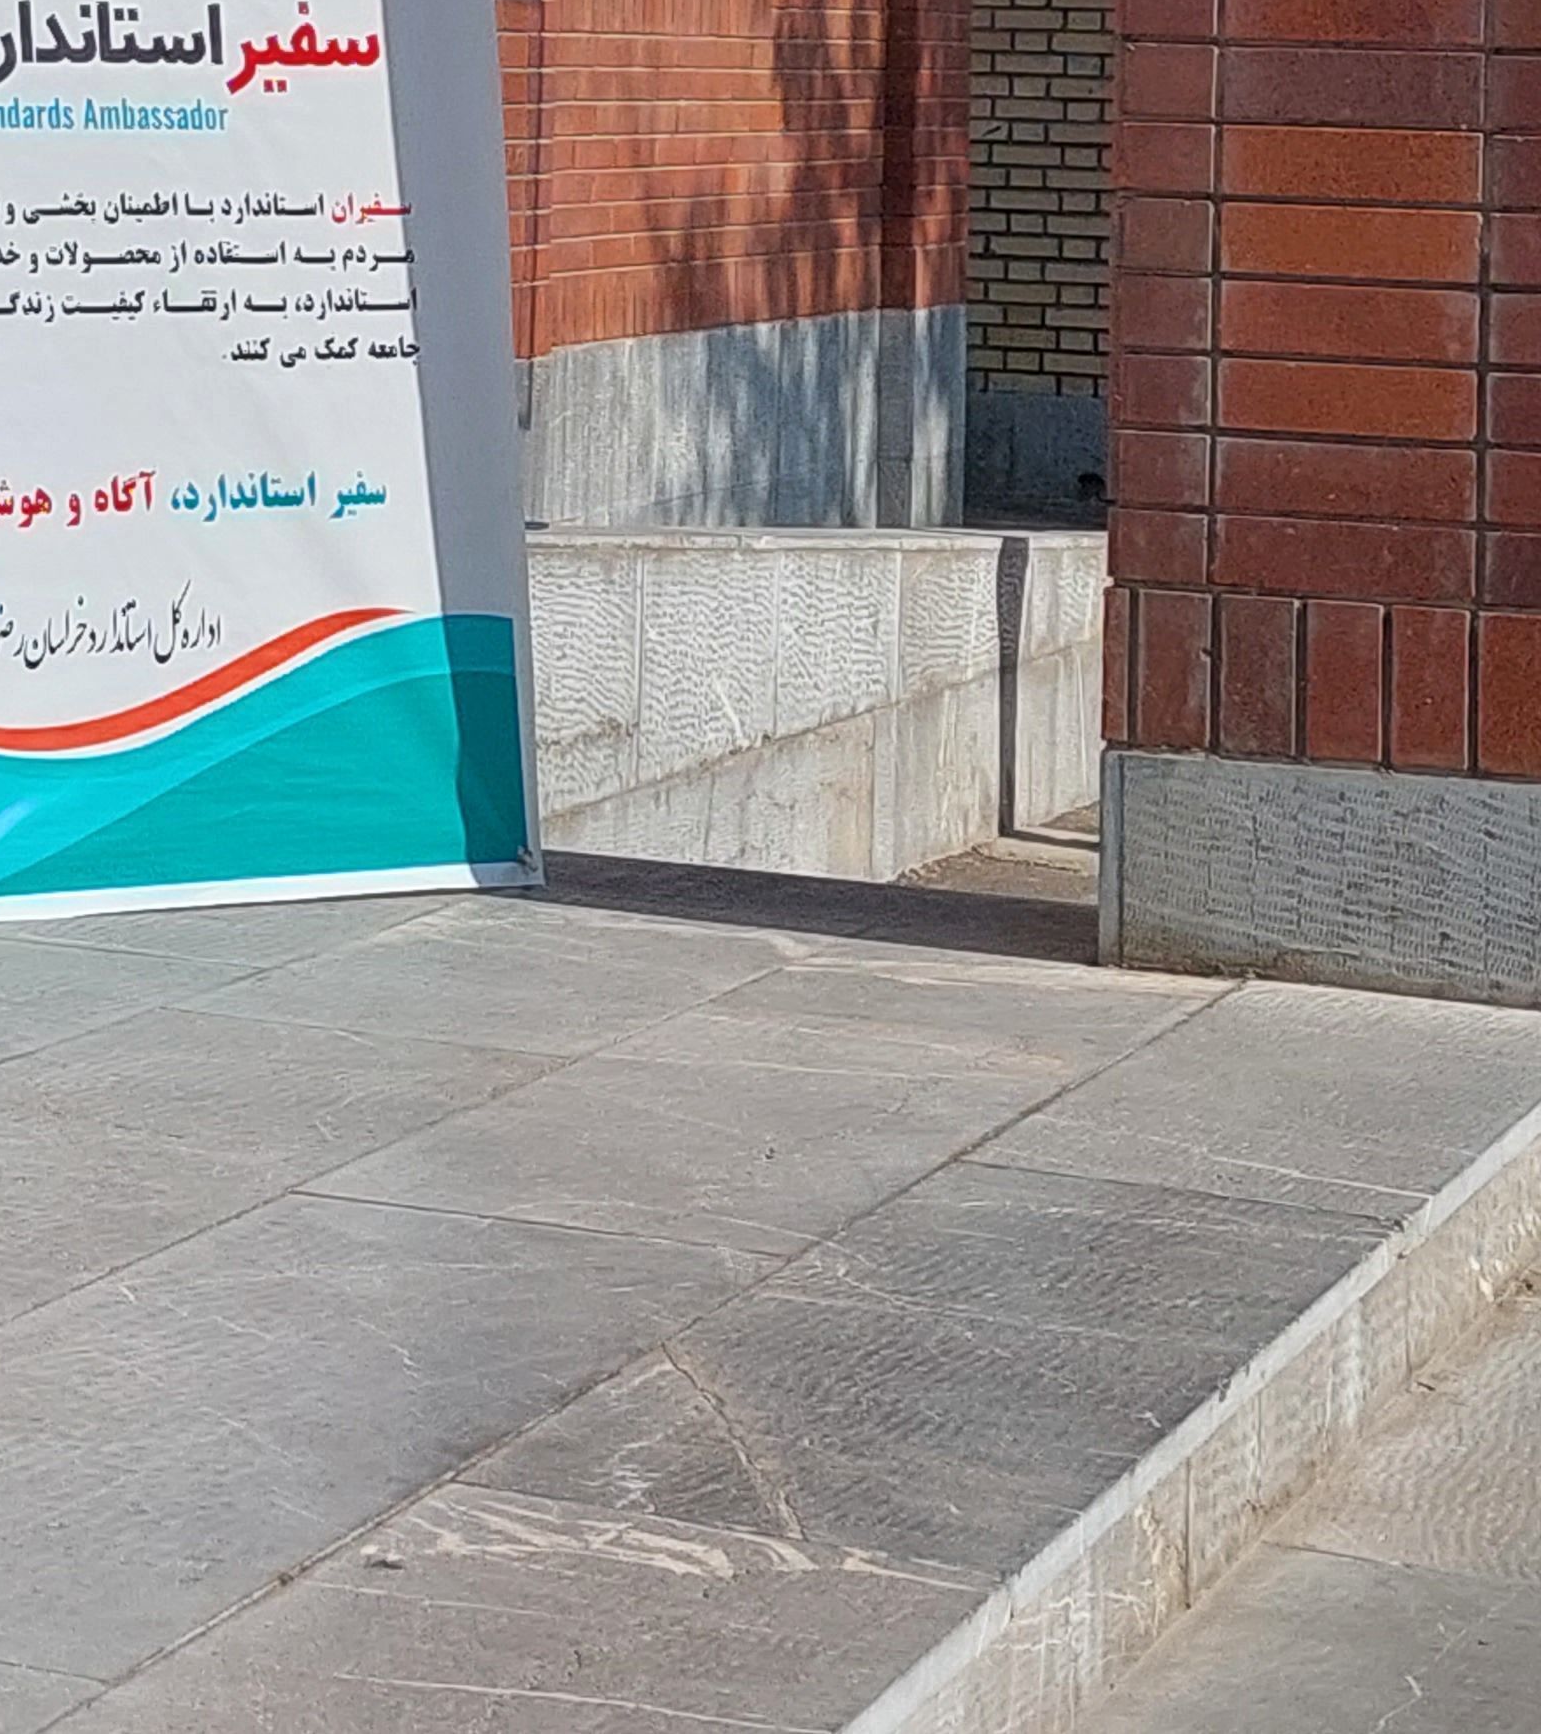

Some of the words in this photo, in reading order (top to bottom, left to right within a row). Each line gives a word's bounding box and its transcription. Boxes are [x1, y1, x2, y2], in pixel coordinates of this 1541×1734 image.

[226, 1, 381, 95] سفیر
[83, 98, 229, 131] Ambassador
[4, 201, 16, 225] و
[23, 192, 97, 225] بخشی
[104, 192, 178, 225] اطمینان
[184, 192, 214, 223] با
[221, 191, 325, 225] استاندارد
[331, 192, 413, 224] سفیران
[28, 251, 39, 274] و
[45, 240, 162, 274] محصولات
[169, 240, 187, 273] از
[293, 245, 337, 271] به
[342, 243, 416, 272] مردم
[61, 289, 146, 320] کیفیت
[153, 287, 237, 320] ارتقاء
[243, 293, 287, 319] به
[295, 287, 418, 320] استاندارد،
[279, 346, 307, 368] می
[314, 336, 359, 360] کمک
[367, 335, 421, 366] جامعه
[94, 469, 157, 514] آگاه
[170, 470, 317, 523] استاندارد،
[328, 469, 388, 520] سفیر
[66, 491, 81, 527] و
[24, 594, 88, 670] خراسان
[153, 579, 191, 665] کل
[181, 607, 222, 650] اداره
